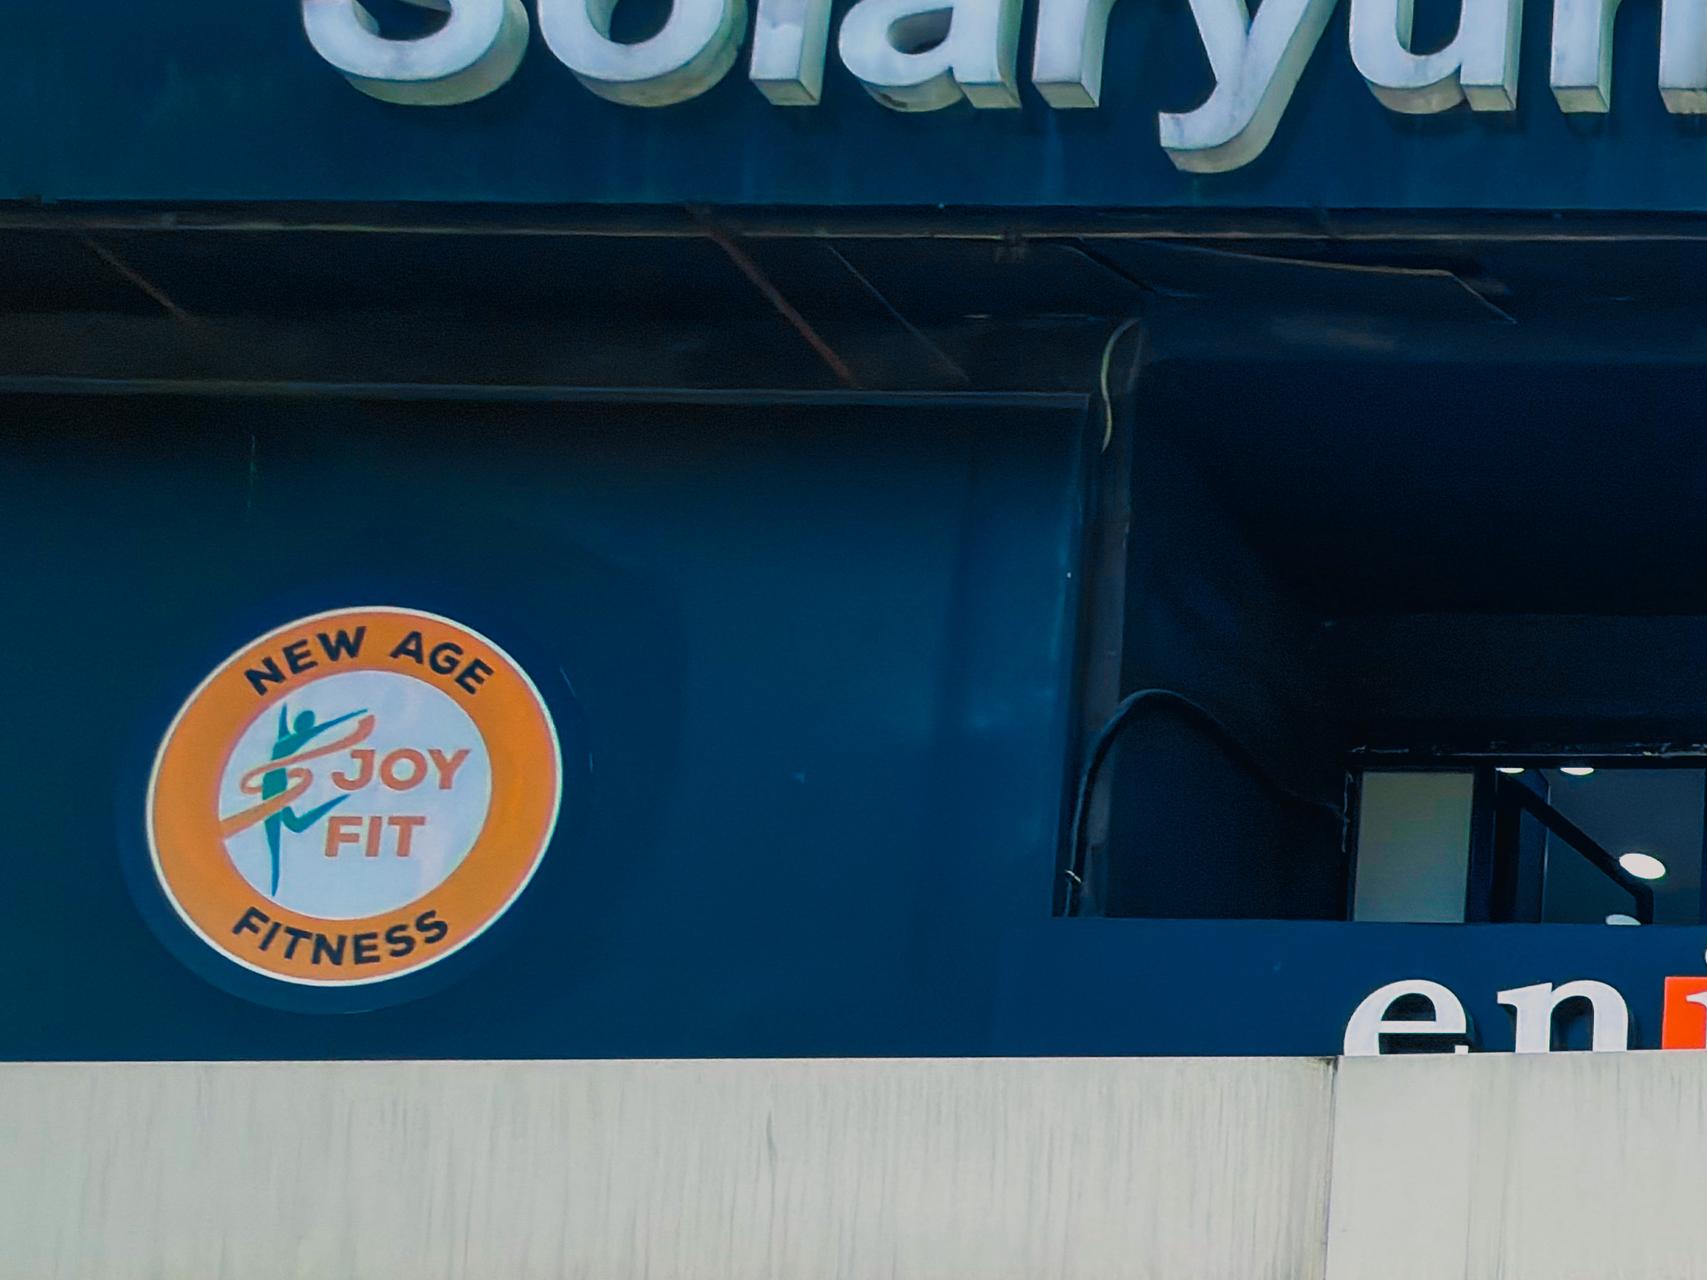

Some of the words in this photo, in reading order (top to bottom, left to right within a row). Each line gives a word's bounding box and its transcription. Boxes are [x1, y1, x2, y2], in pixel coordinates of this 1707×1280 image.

[244, 626, 367, 697] NEW
[389, 631, 496, 695] AGE
[331, 748, 472, 792] JOY
[324, 815, 427, 858] FIT
[232, 907, 449, 966] FITNESS
